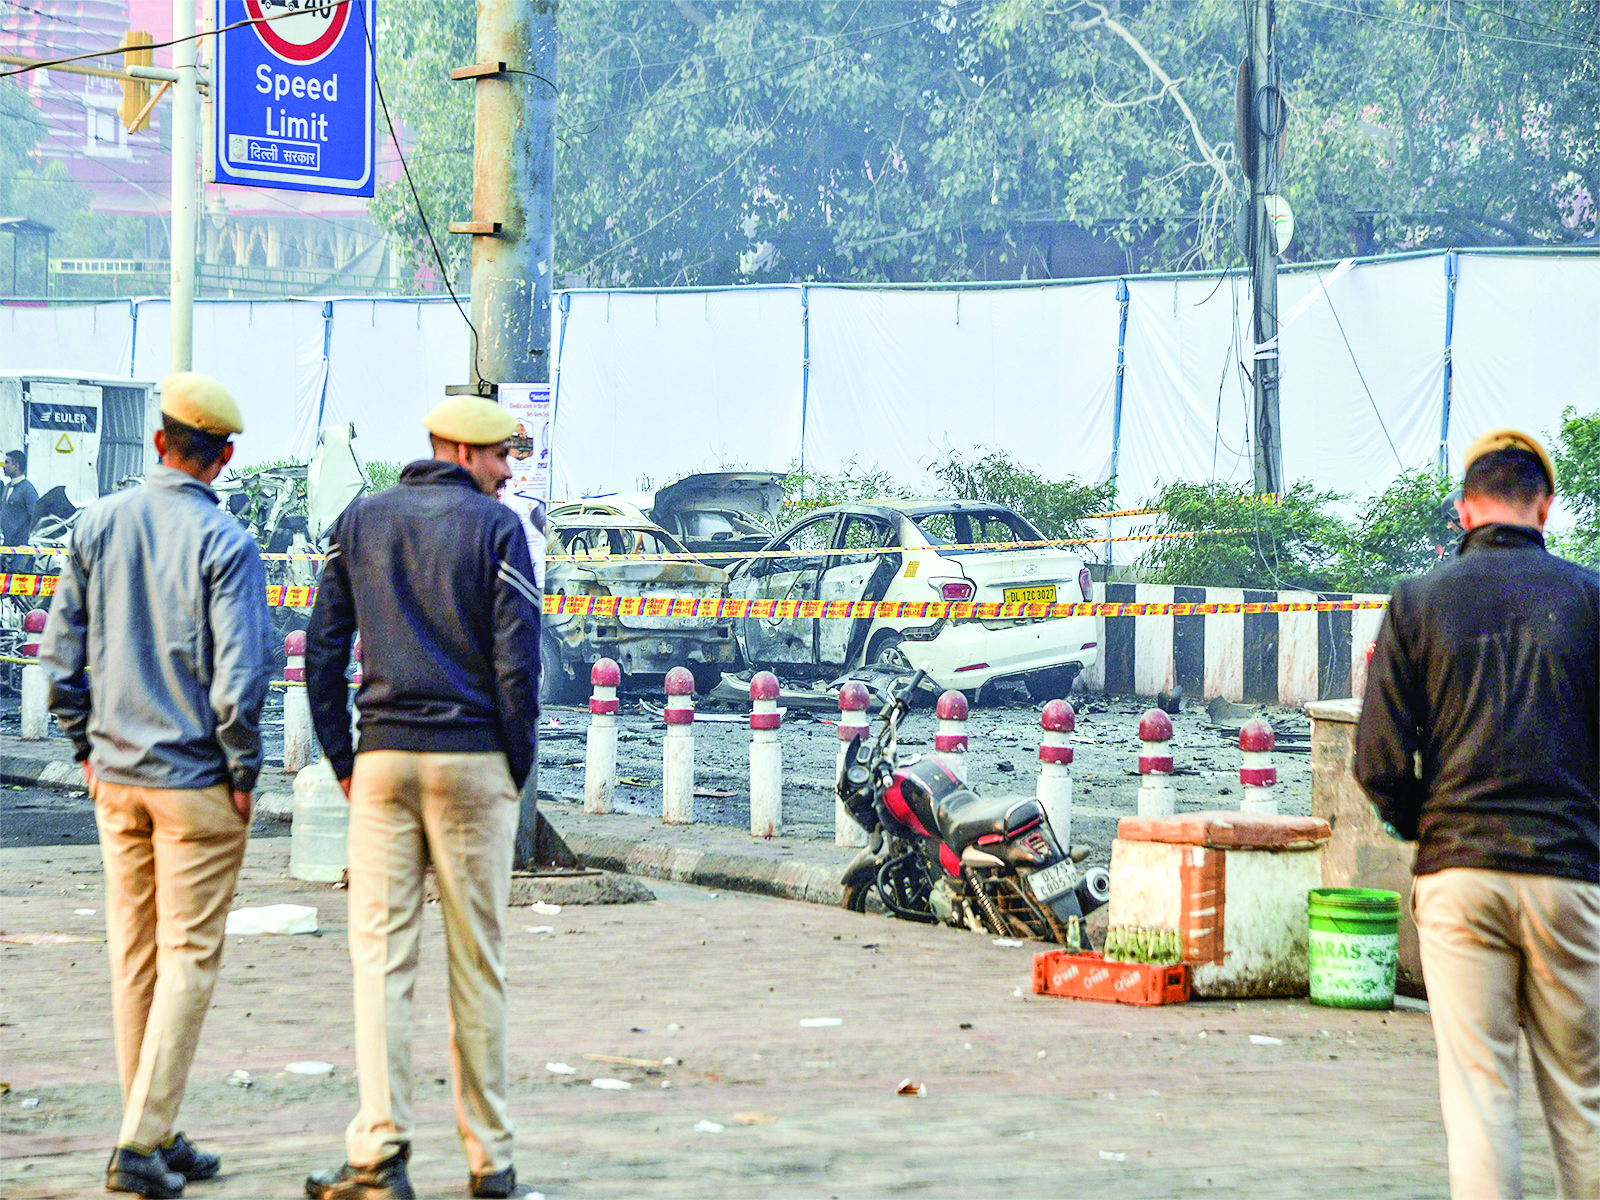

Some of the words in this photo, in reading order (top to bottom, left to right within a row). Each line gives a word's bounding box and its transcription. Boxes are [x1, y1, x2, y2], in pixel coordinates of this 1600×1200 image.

[256, 64, 338, 102] Speed
[266, 107, 328, 142] Limit
[250, 142, 278, 162] दिल्ली
[282, 149, 316, 166] सरकार
[54, 412, 88, 424] EULER
[1011, 592, 1020, 602] DL
[1022, 590, 1036, 601] 1ZC
[1037, 589, 1054, 599] 3027
[1052, 964, 1079, 987] Crush
[1083, 968, 1110, 989] Crush
[1114, 970, 1141, 992] Crush
